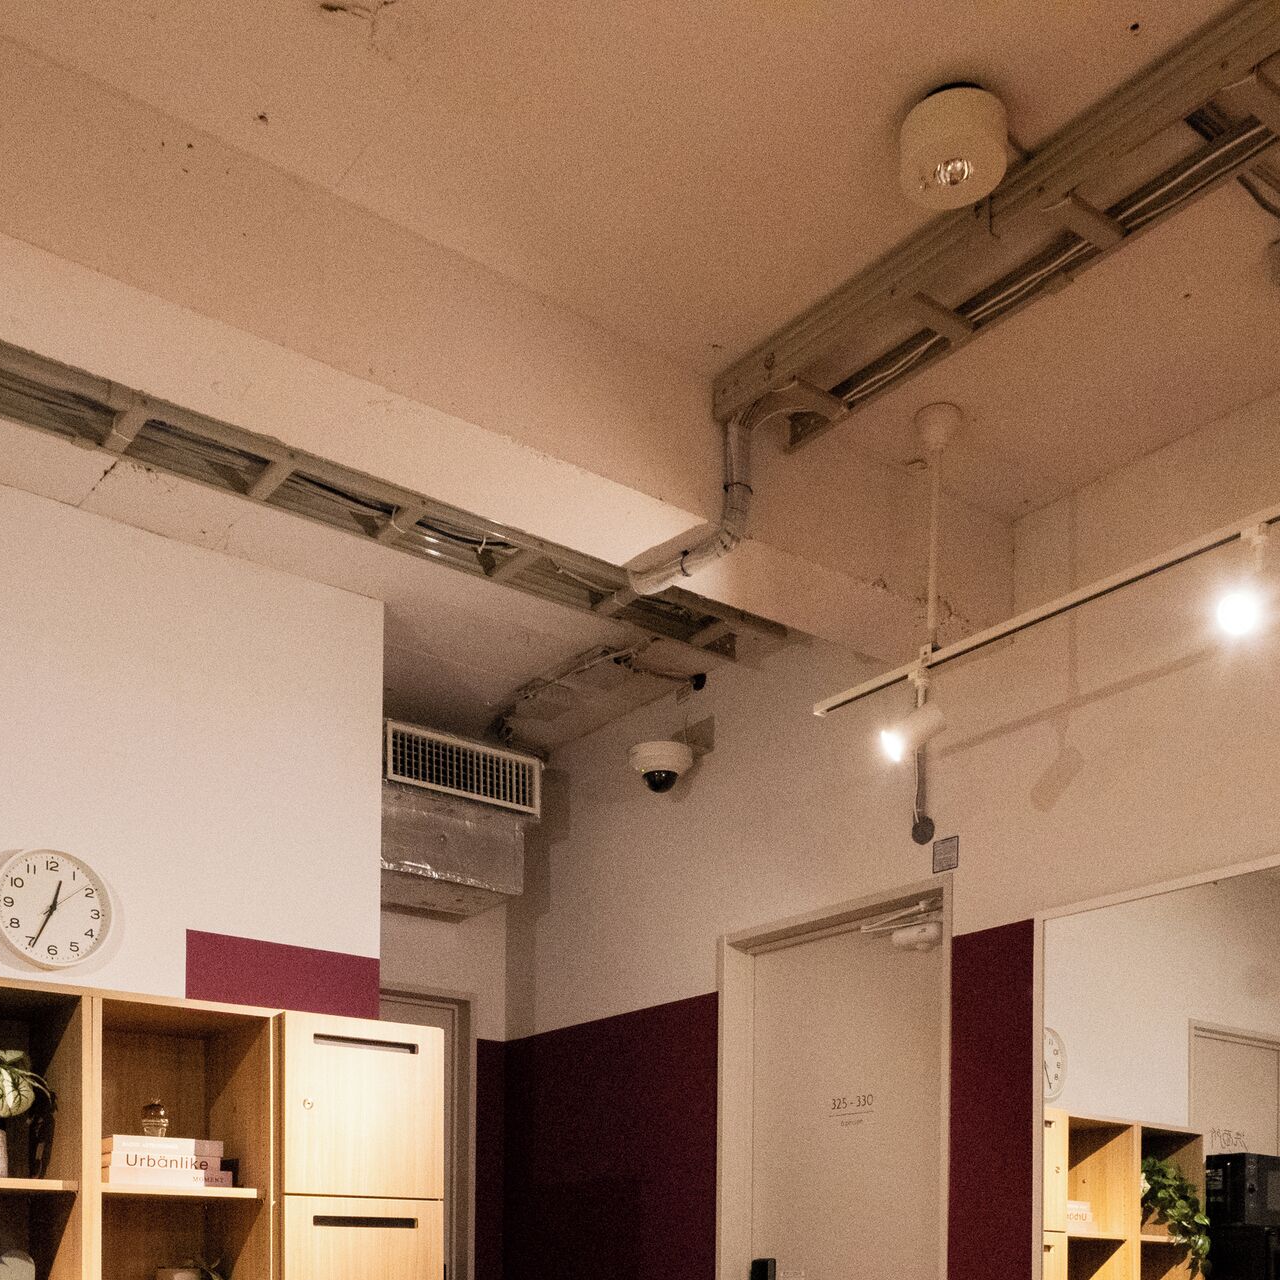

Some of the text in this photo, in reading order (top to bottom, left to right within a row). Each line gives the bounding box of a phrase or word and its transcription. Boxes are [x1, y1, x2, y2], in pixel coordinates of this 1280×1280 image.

[26, 863, 36, 875] 11
[45, 860, 59, 872] 12
[10, 877, 24, 888] 10
[84, 887, 94, 898] 2
[3, 896, 14, 907] 9
[90, 909, 100, 920] 3
[9, 917, 20, 928] 8
[84, 928, 94, 938] 4
[25, 935, 35, 946] 7
[47, 945, 58, 956] 6
[69, 941, 79, 952] 5
[126, 1153, 209, 1171] Urbänlike
[192, 1176, 225, 1184] MOMENT
